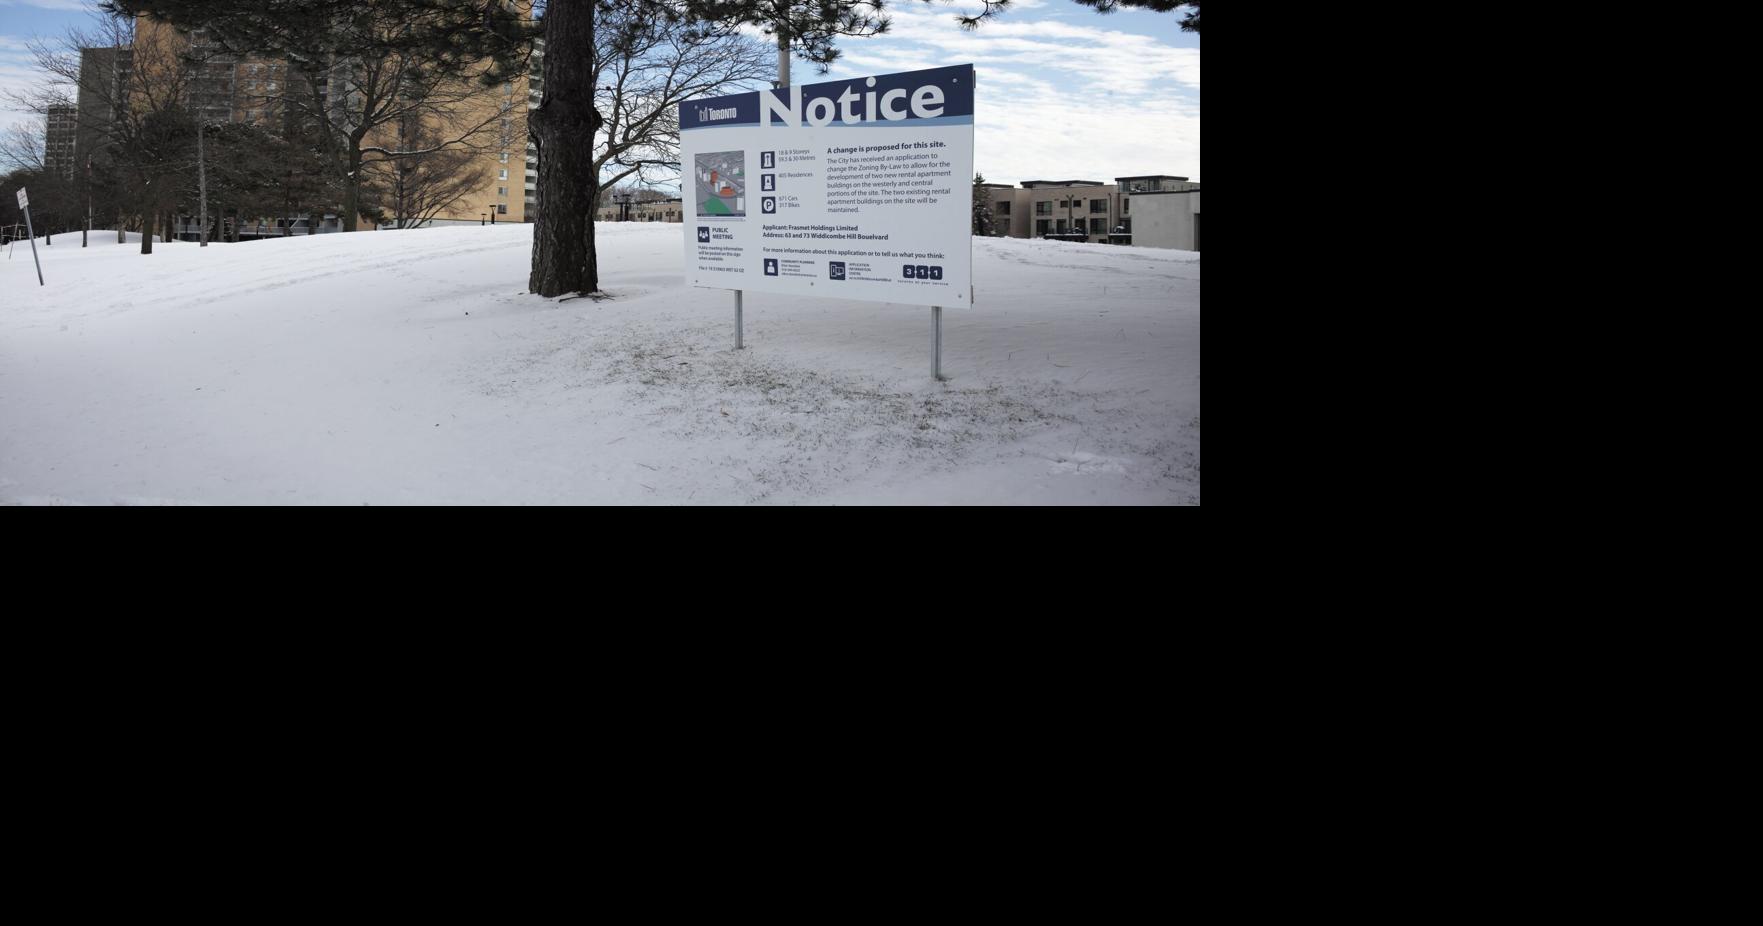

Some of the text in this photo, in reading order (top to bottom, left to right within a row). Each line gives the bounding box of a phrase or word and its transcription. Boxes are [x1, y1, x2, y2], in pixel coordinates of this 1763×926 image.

[760, 76, 944, 127] Notice
[708, 108, 736, 120] TORONTO
[833, 146, 857, 154] change
[866, 143, 900, 152] proposed
